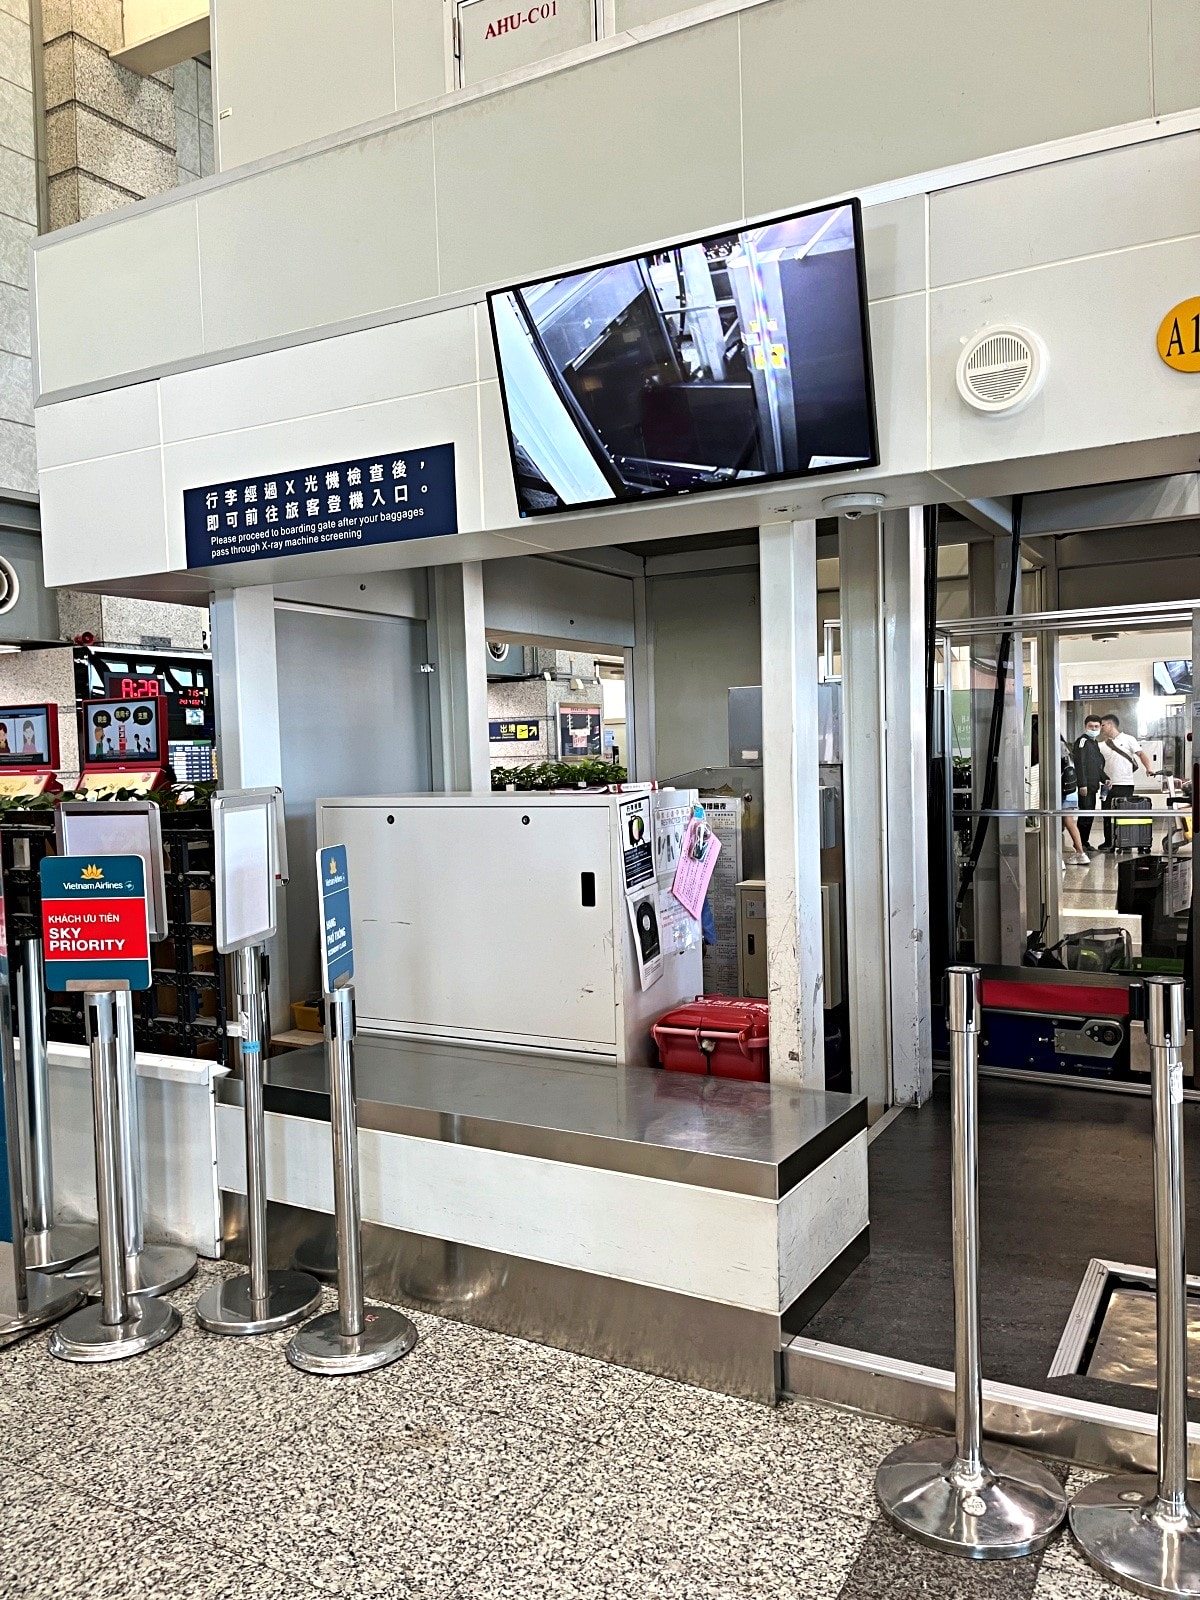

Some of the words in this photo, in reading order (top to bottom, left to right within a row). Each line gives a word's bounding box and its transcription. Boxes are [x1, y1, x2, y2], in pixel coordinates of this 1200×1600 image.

[485, 1, 557, 39] AHU-C01
[206, 484, 428, 532] 即可前往旅客登機入口。
[211, 535, 237, 546] Please
[238, 529, 270, 543] proceed
[271, 528, 279, 537] to
[280, 523, 316, 536] boarding
[317, 520, 336, 532] gate
[338, 517, 358, 527] after
[359, 514, 379, 526] your
[380, 508, 424, 522] baggages
[211, 547, 230, 559] pass
[231, 543, 260, 554] through
[262, 541, 283, 550] X-ray
[285, 535, 319, 547] machine
[320, 529, 362, 542] screening
[500, 724, 516, 734] 出境
[63, 882, 94, 890] Vietnam
[95, 881, 123, 889] Airlines
[48, 913, 81, 923] KHÁCH
[99, 912, 120, 922] TIÊN
[49, 927, 81, 939] SKY
[49, 939, 126, 951] PRIORITY
